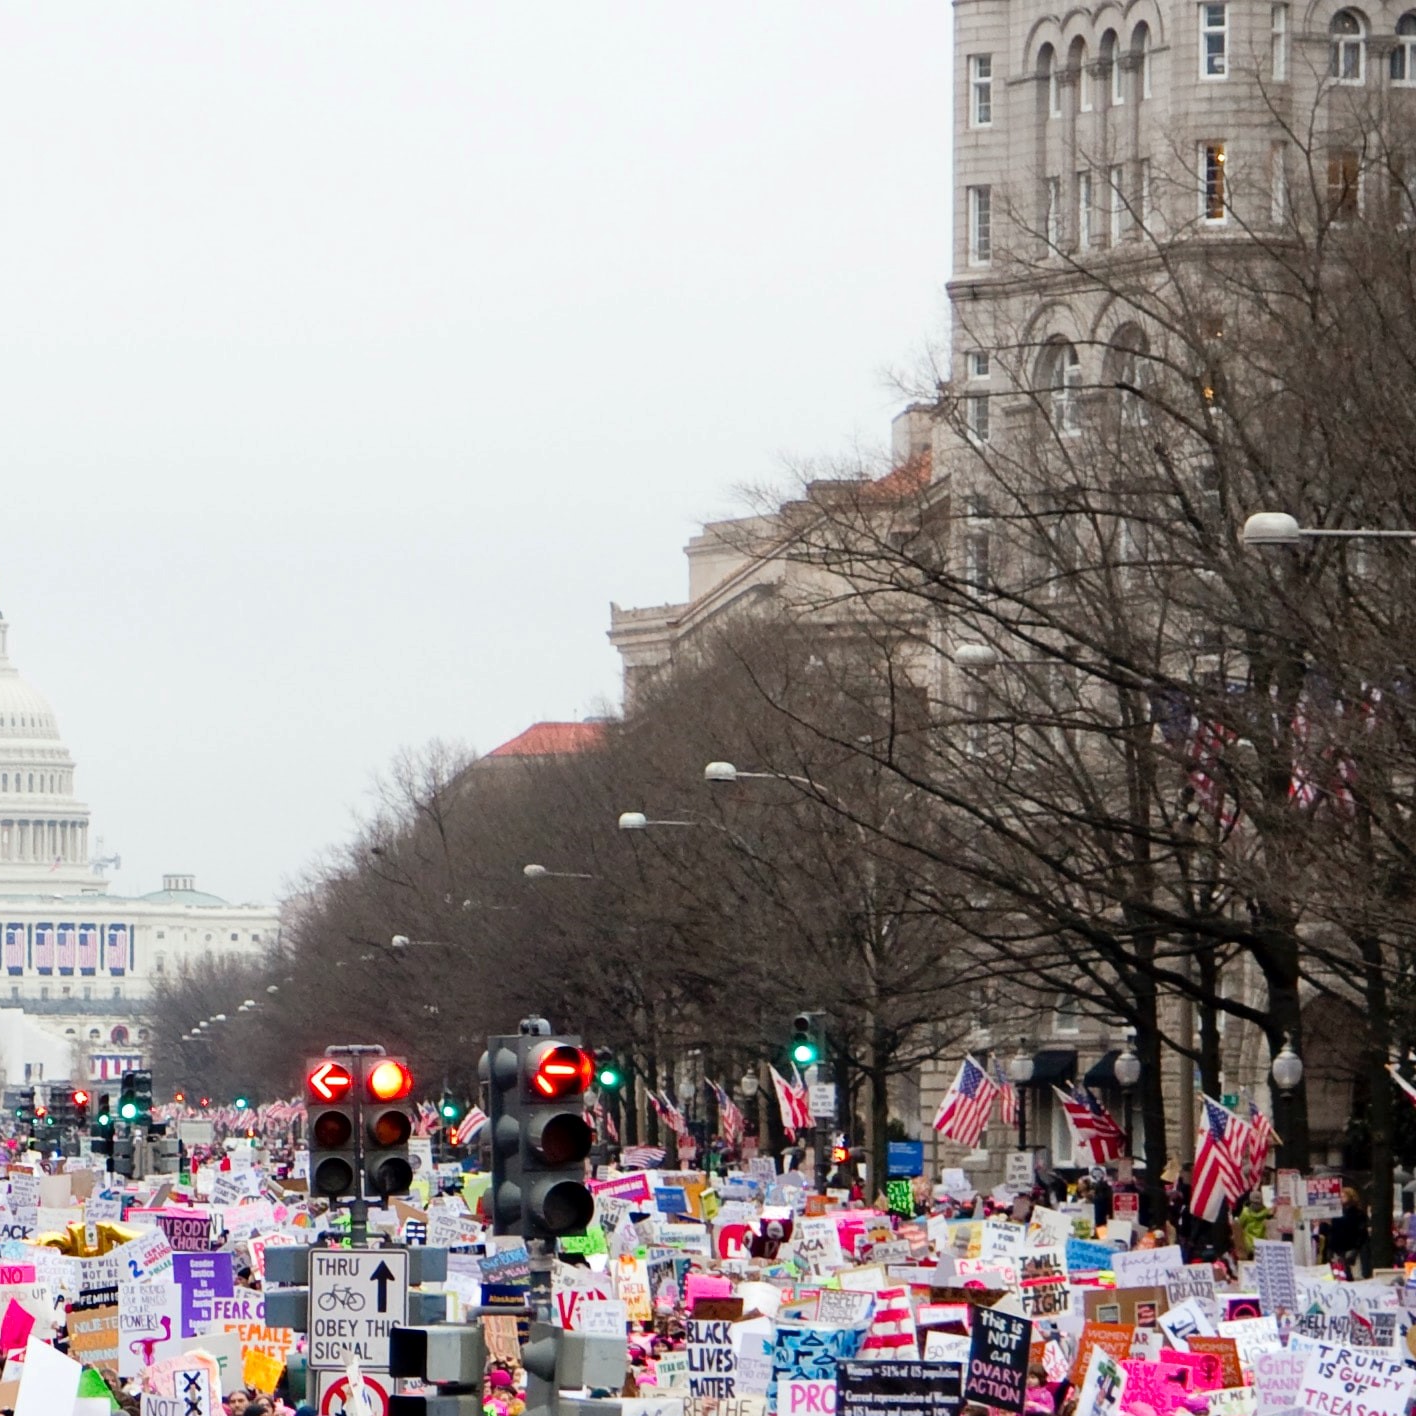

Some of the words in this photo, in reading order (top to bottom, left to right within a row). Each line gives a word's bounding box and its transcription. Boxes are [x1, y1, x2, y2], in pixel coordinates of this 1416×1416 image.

[0, 1269, 22, 1283] NO
[317, 1258, 360, 1276] THRU
[214, 1301, 249, 1320] FEAR
[1023, 1292, 1070, 1310] FIGHT
[315, 1319, 360, 1337] OBEY
[980, 1311, 1007, 1332] this
[1012, 1316, 1024, 1334] is
[687, 1322, 732, 1345] BLACK
[988, 1331, 1022, 1349] NOT
[315, 1343, 373, 1360] SIGNAL
[688, 1348, 734, 1372] LIVES
[990, 1350, 1012, 1365] an
[1318, 1344, 1403, 1376] TRUMP
[971, 1359, 1022, 1383] OVARY
[1317, 1362, 1334, 1379] IS
[1339, 1368, 1406, 1391] GUILTY
[690, 1378, 735, 1399] MATTER
[968, 1379, 1020, 1403] ACTION
[1344, 1382, 1368, 1396] OF
